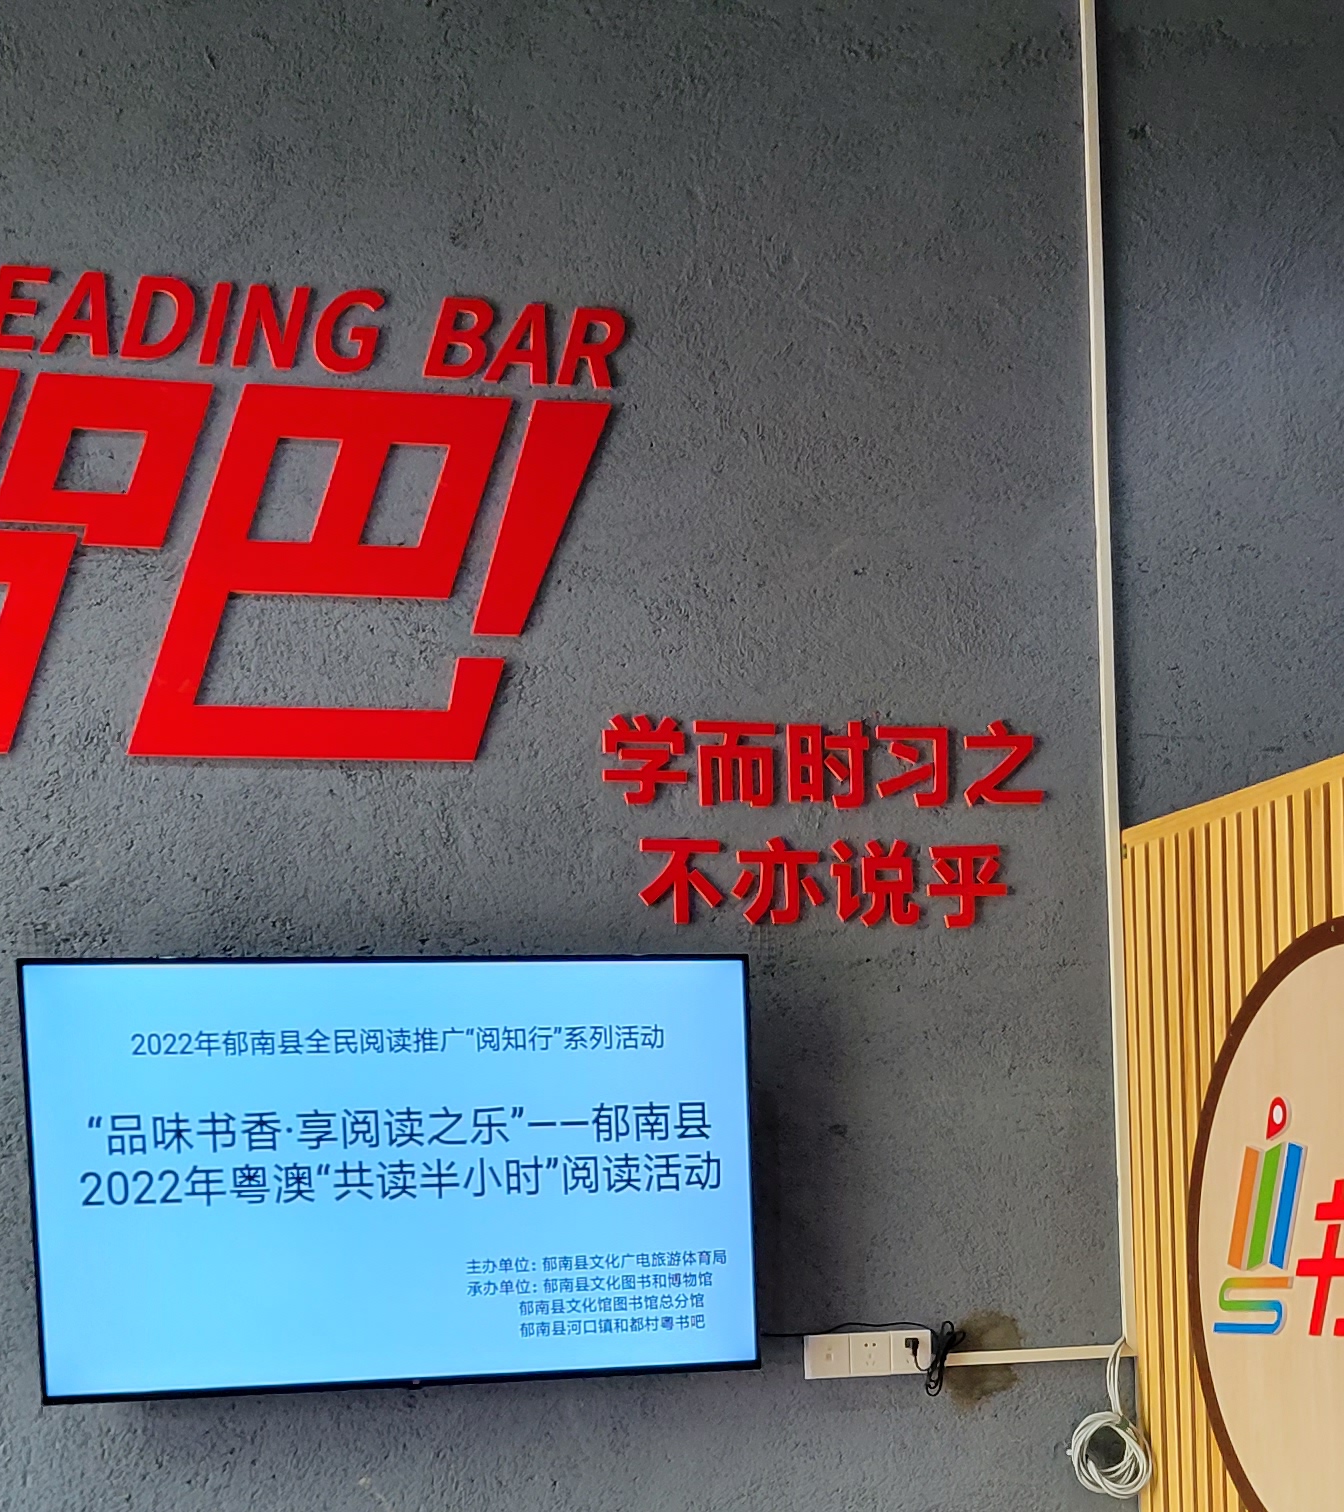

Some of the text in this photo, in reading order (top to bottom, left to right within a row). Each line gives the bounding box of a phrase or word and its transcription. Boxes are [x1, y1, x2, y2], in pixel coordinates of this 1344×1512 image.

[422, 296, 627, 389] BAR
[600, 713, 1046, 811] 学而时习之
[637, 835, 1008, 930] 不亦说乎
